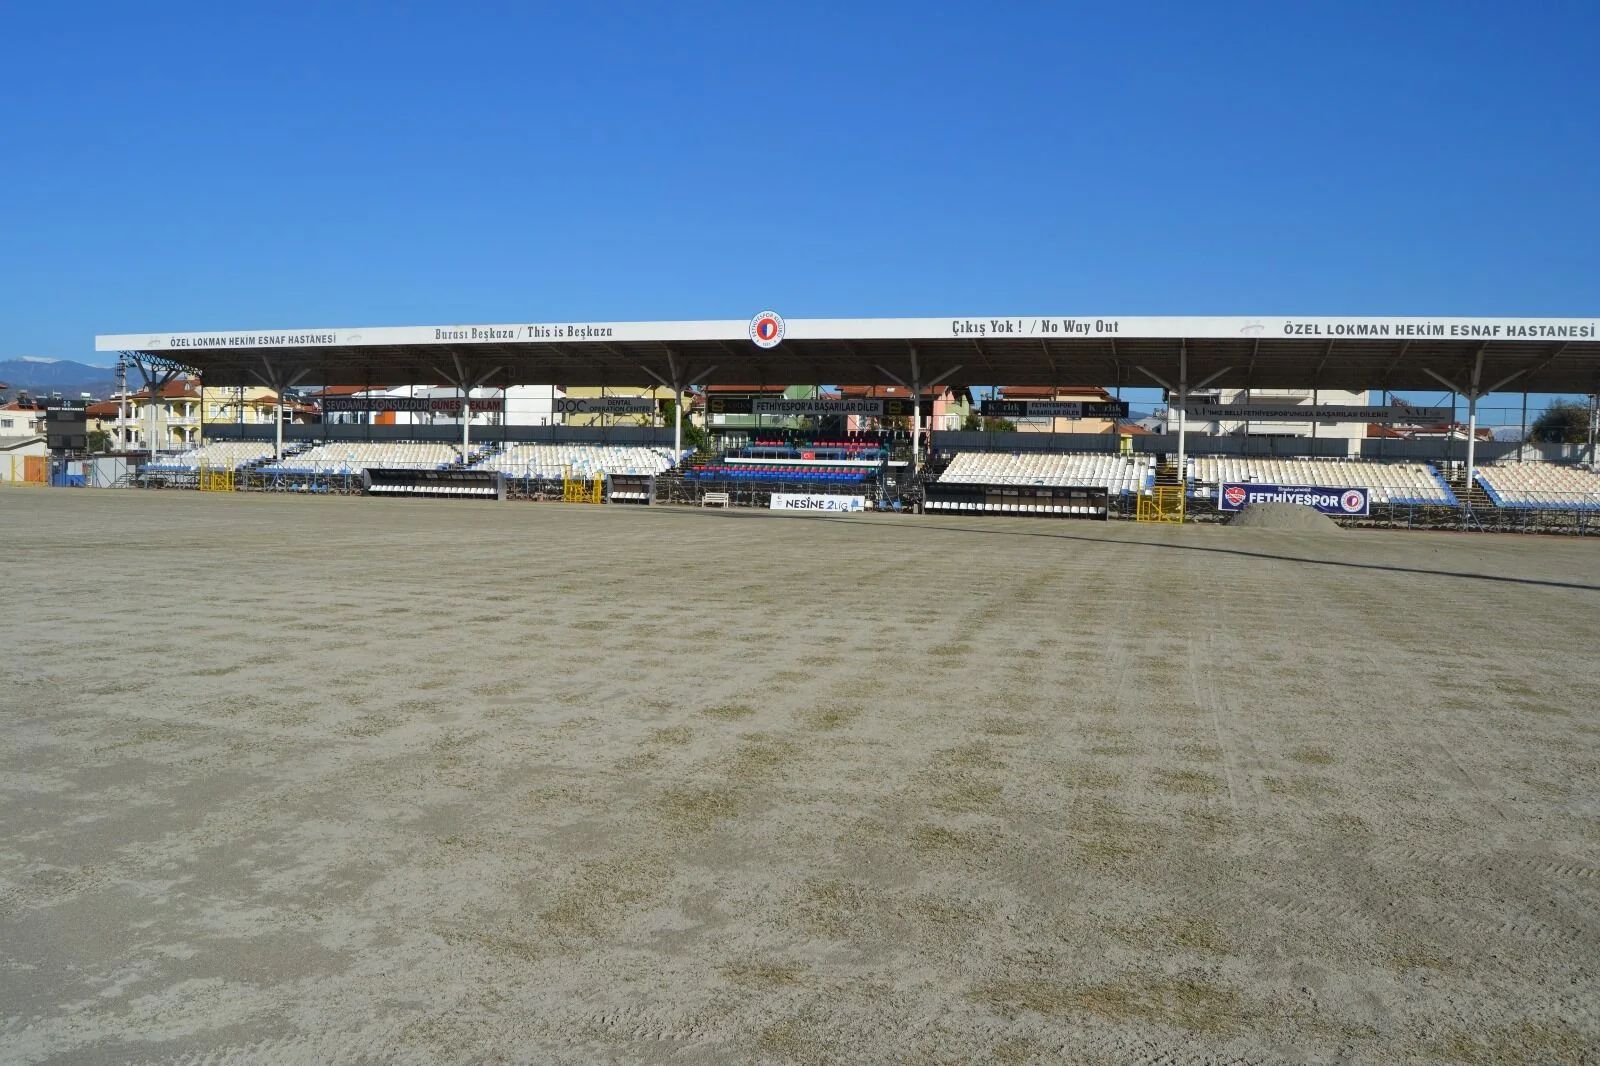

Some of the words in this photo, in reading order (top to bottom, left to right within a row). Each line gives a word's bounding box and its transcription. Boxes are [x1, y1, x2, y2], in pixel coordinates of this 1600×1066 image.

[435, 329, 468, 340] Burası
[471, 328, 514, 341] Beşkaza
[528, 326, 551, 338] This
[554, 326, 564, 337] is
[567, 325, 613, 340] Beşkaza
[952, 320, 986, 336] Çıkış
[991, 320, 1013, 333] Yok
[1042, 320, 1058, 333] No
[1063, 320, 1091, 335] Way
[1096, 320, 1119, 333] Out
[1284, 321, 1321, 335] ÖZEL
[1327, 324, 1389, 335] LOKMAN
[1395, 321, 1444, 336] HEKİM
[1450, 325, 1501, 336] ESNAF
[1507, 323, 1595, 337] HASTANESİ
[170, 336, 190, 347] ÖZEL
[193, 337, 227, 347] LOKMAN
[229, 334, 255, 346] HEKİM
[258, 335, 286, 345] ESNAF
[288, 332, 336, 345] HASTANESİ
[557, 400, 587, 412] DOC
[814, 401, 856, 413] BAŞARILAR
[857, 400, 879, 412] DİLER
[1249, 491, 1338, 507] FETHİYESPOR
